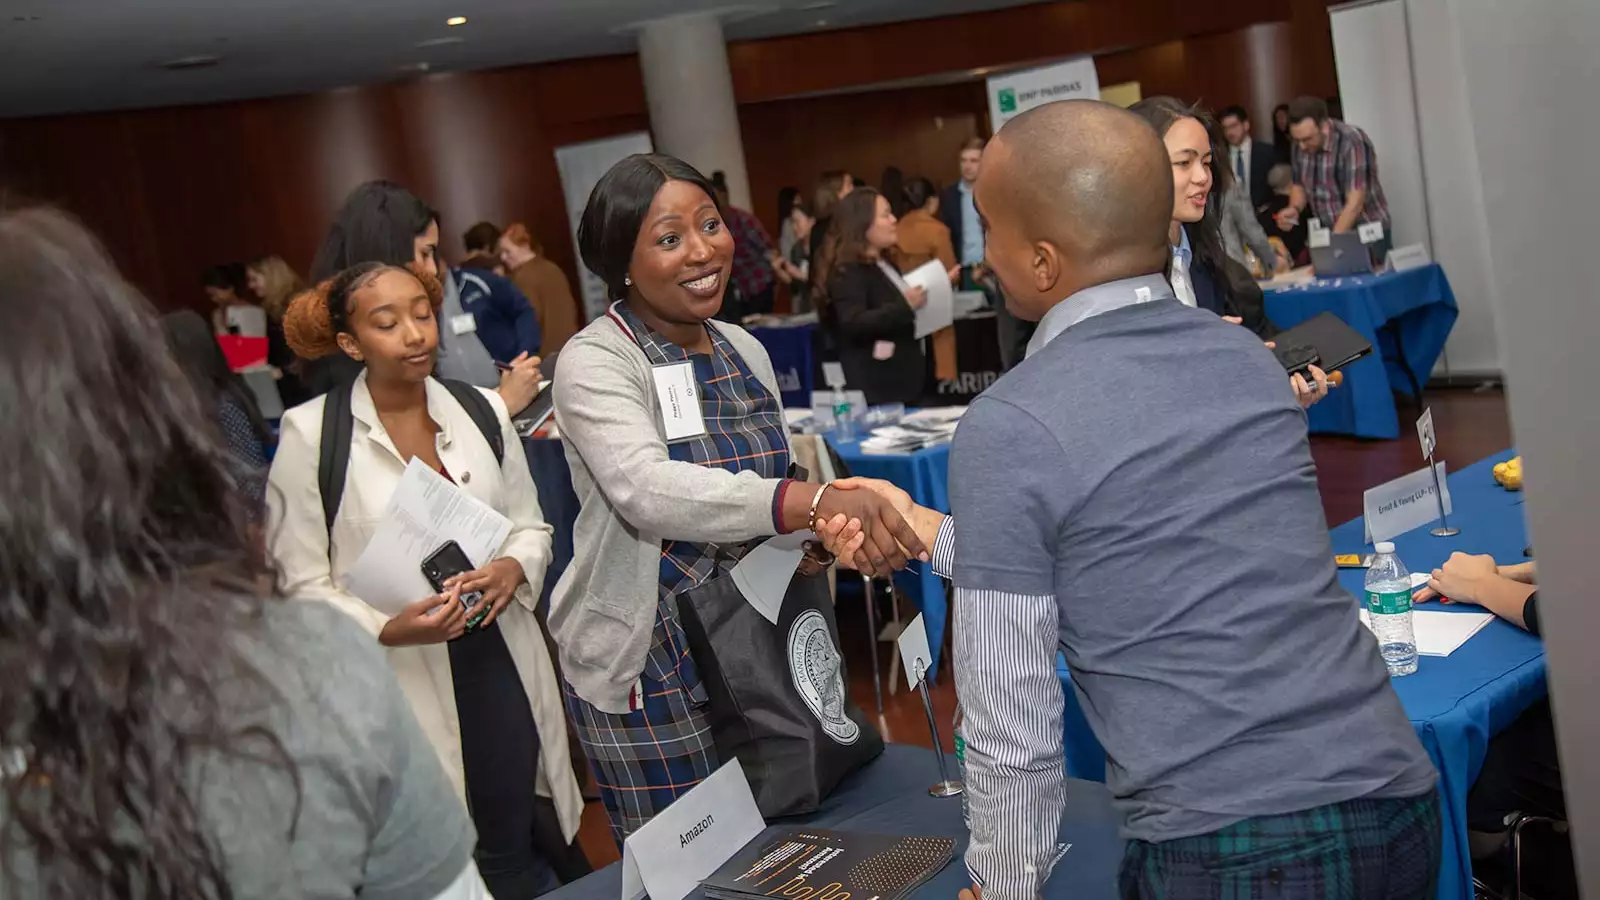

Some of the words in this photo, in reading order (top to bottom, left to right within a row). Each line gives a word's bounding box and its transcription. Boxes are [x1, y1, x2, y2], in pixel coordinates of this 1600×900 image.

[1378, 502, 1392, 514] Ernst
[1399, 495, 1415, 506] Young
[679, 813, 714, 848] Amazon
